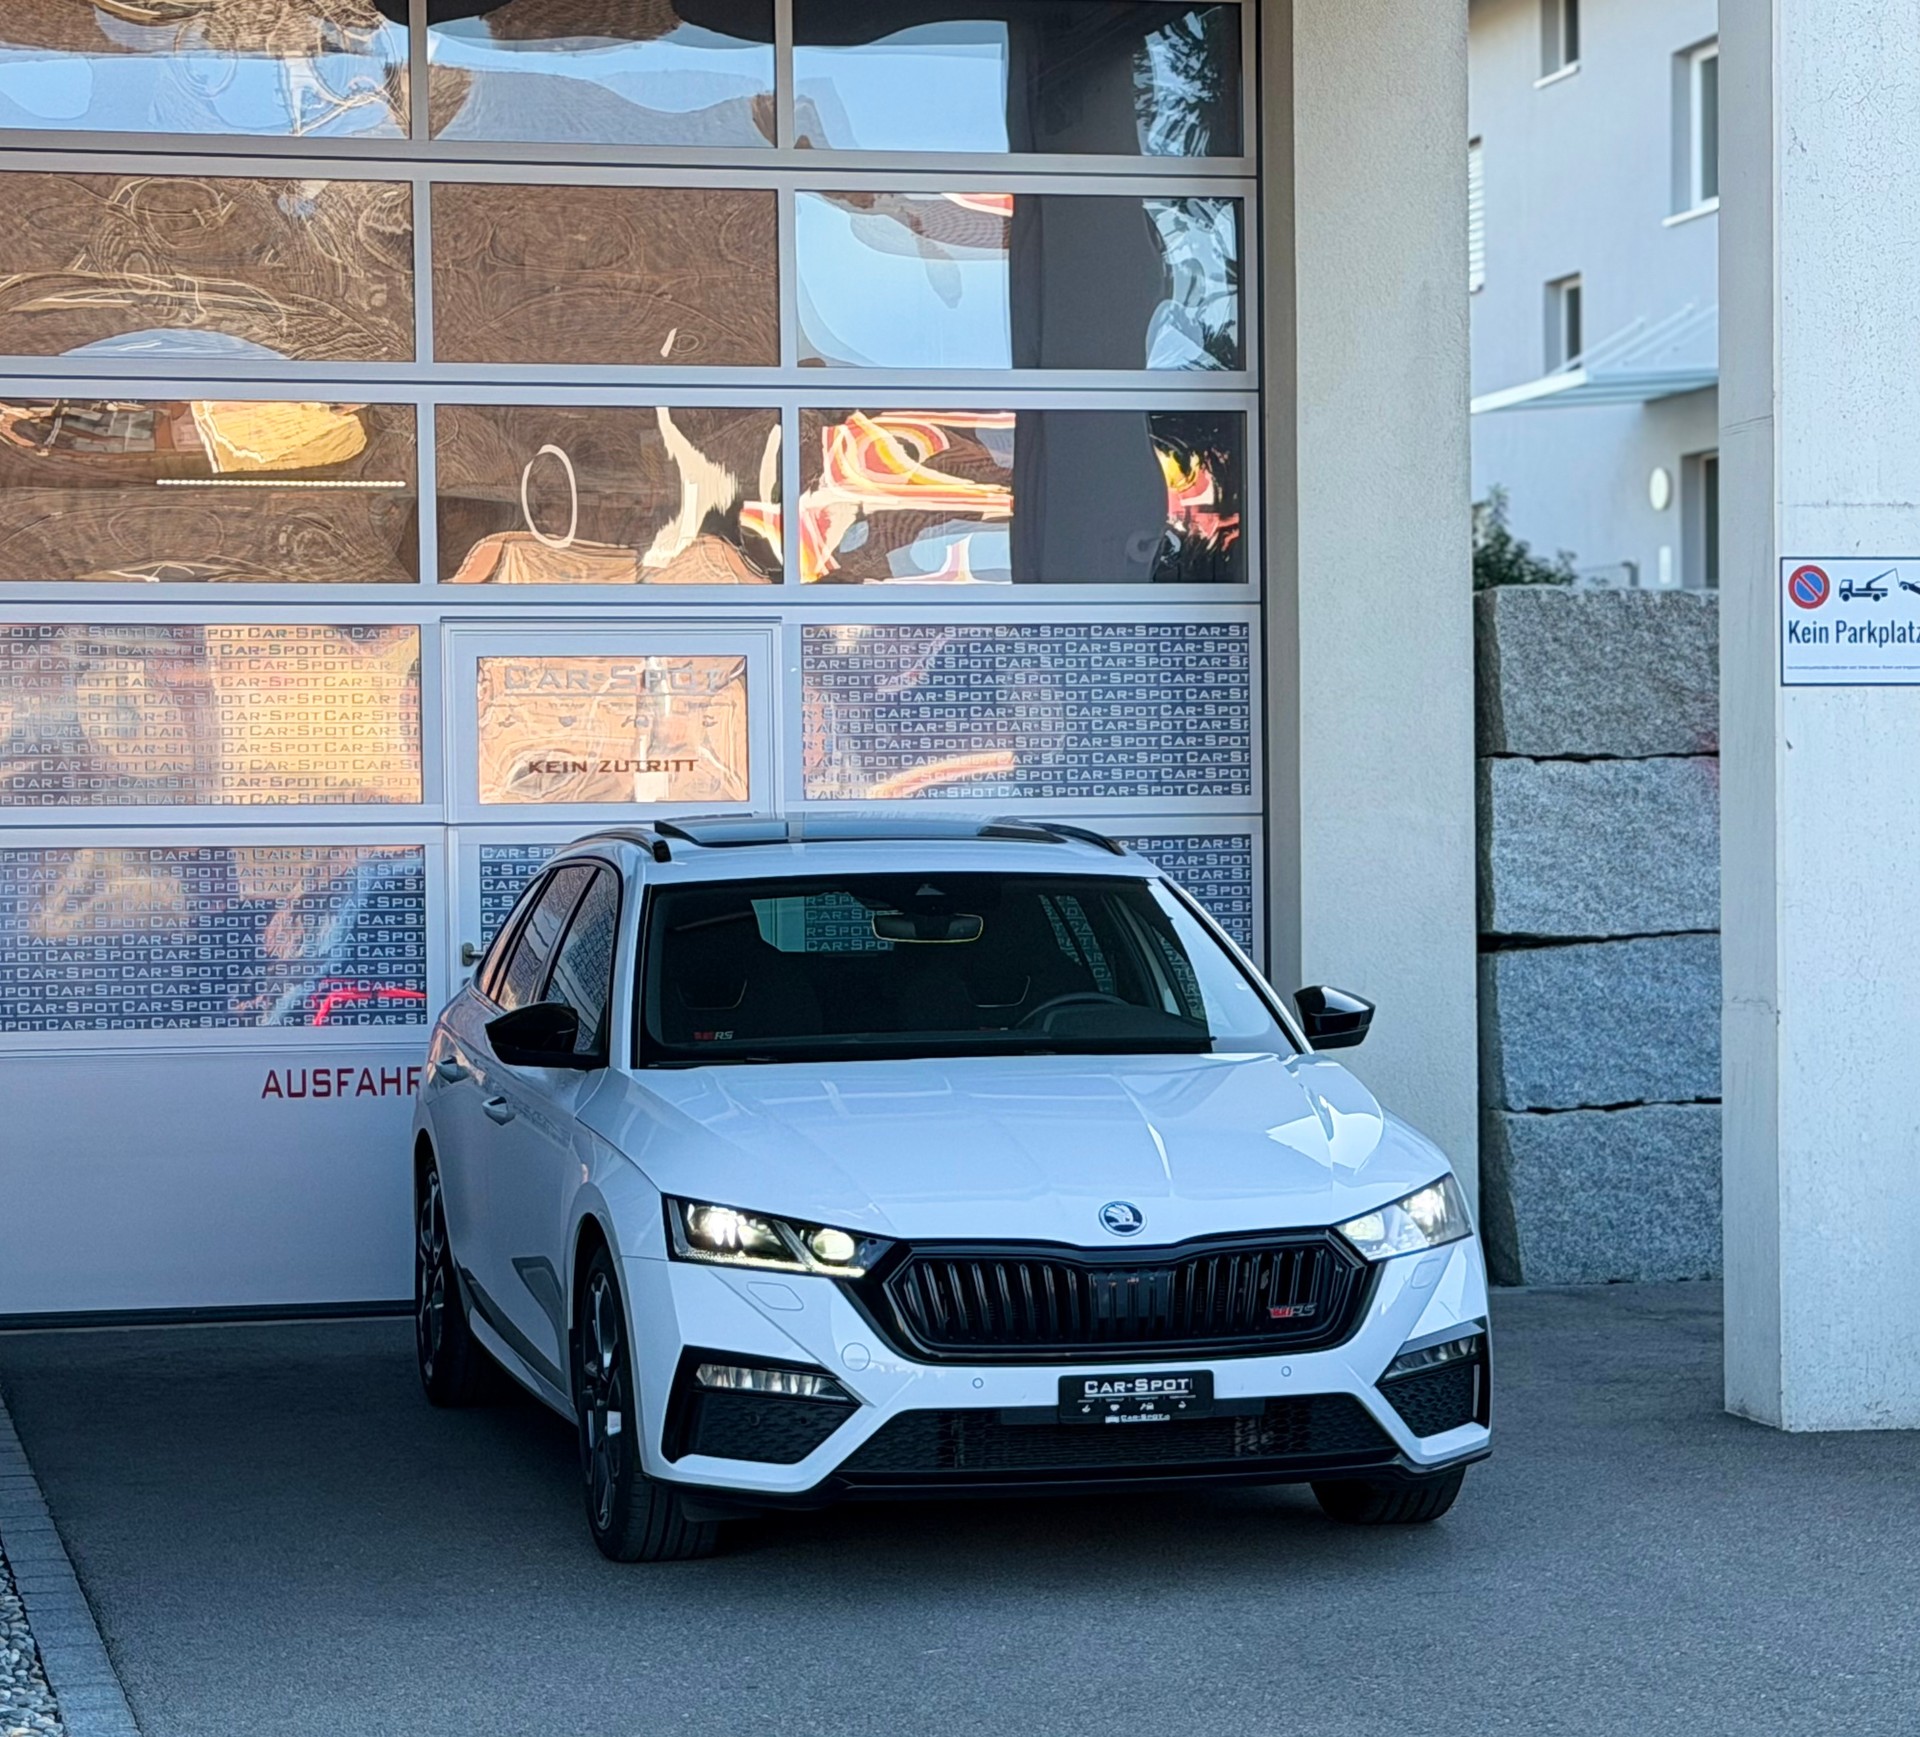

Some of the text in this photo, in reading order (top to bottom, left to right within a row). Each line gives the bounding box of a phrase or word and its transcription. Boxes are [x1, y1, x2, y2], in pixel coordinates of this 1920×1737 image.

[1788, 620, 1830, 644] Kein
[528, 759, 699, 773] KEIN ZUTRITT
[1084, 1378, 1189, 1394] CAR-SPOT
